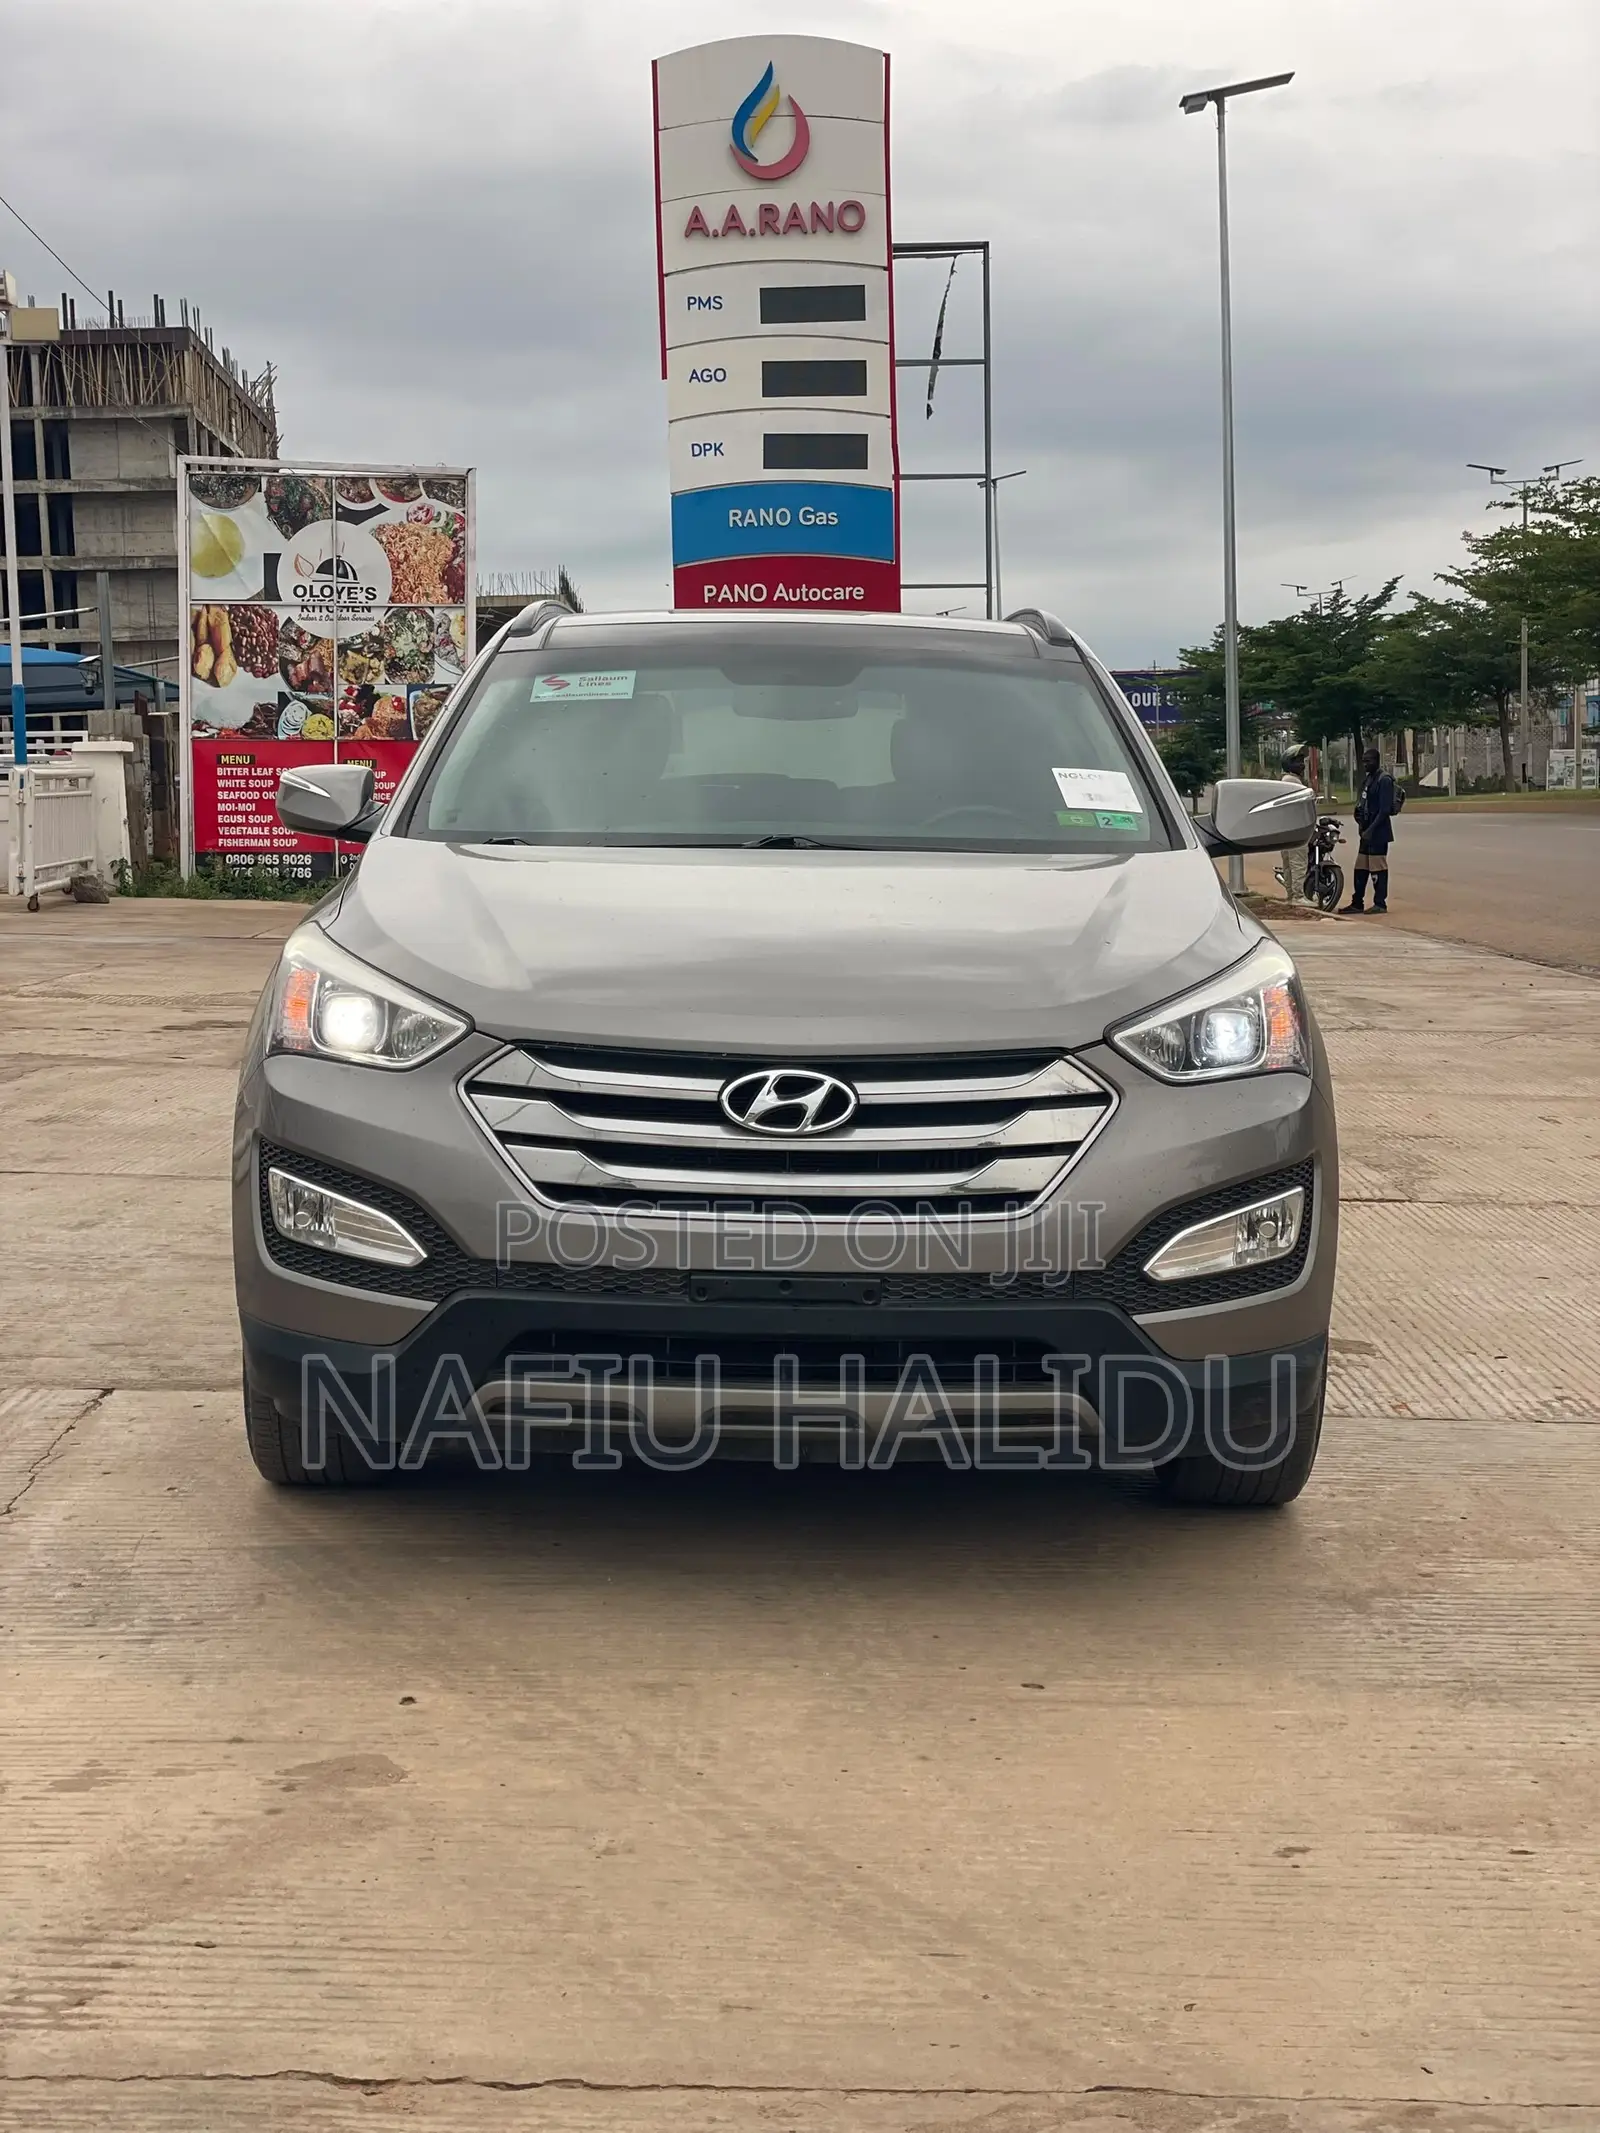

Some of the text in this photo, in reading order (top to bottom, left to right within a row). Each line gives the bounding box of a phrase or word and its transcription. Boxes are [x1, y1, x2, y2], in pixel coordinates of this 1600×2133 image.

[685, 200, 866, 237] A.A.RANO
[687, 296, 723, 311] PMS
[689, 368, 727, 383] AGO
[691, 442, 725, 457] DPK
[728, 506, 839, 527] RANO Gas
[293, 584, 377, 601] OLOYE'S
[703, 583, 865, 603] PANO Autocare
[351, 613, 375, 622] Services
[221, 755, 250, 765] MENU
[217, 767, 249, 776] BITTER
[251, 767, 274, 776] LEAF
[217, 779, 274, 788] WHITE SOUP
[217, 790, 260, 800] SEAFOOD
[372, 792, 391, 801] RICE
[217, 803, 256, 812] MOI-MOI
[217, 814, 273, 823] EGUSI SOUP
[218, 826, 270, 835] VEGETABLE
[218, 838, 298, 847] FISHERMAN SOUP
[257, 854, 280, 865] 965
[282, 854, 312, 865] 9026
